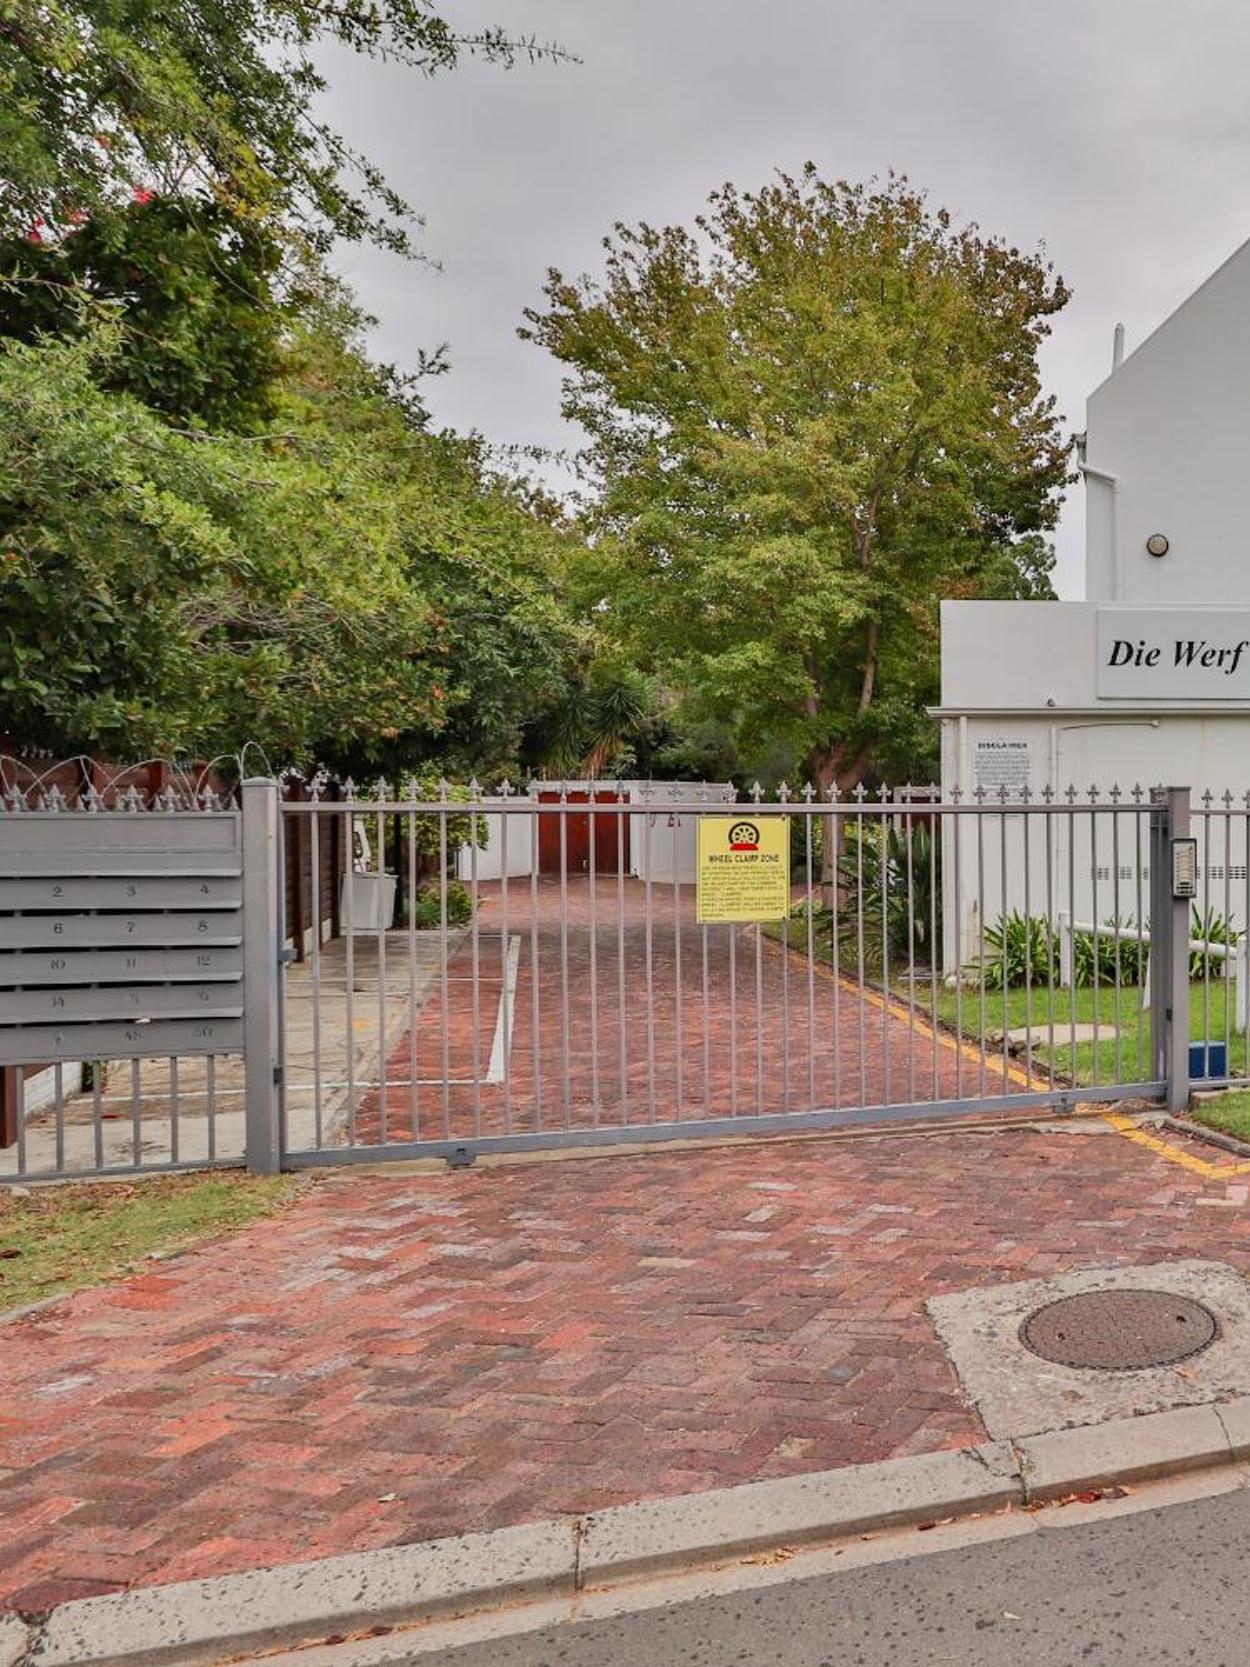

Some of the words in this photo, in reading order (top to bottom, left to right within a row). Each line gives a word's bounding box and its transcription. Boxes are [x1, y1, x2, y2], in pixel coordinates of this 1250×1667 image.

[1107, 639, 1161, 667] Die
[1174, 640, 1250, 675] Werf
[709, 854, 733, 863] WHEEL
[735, 854, 759, 863] CLAMP
[760, 854, 780, 863] ZONE
[52, 886, 63, 898] 2
[127, 885, 137, 897] 3
[200, 884, 209, 895] 4
[53, 922, 63, 934] 6
